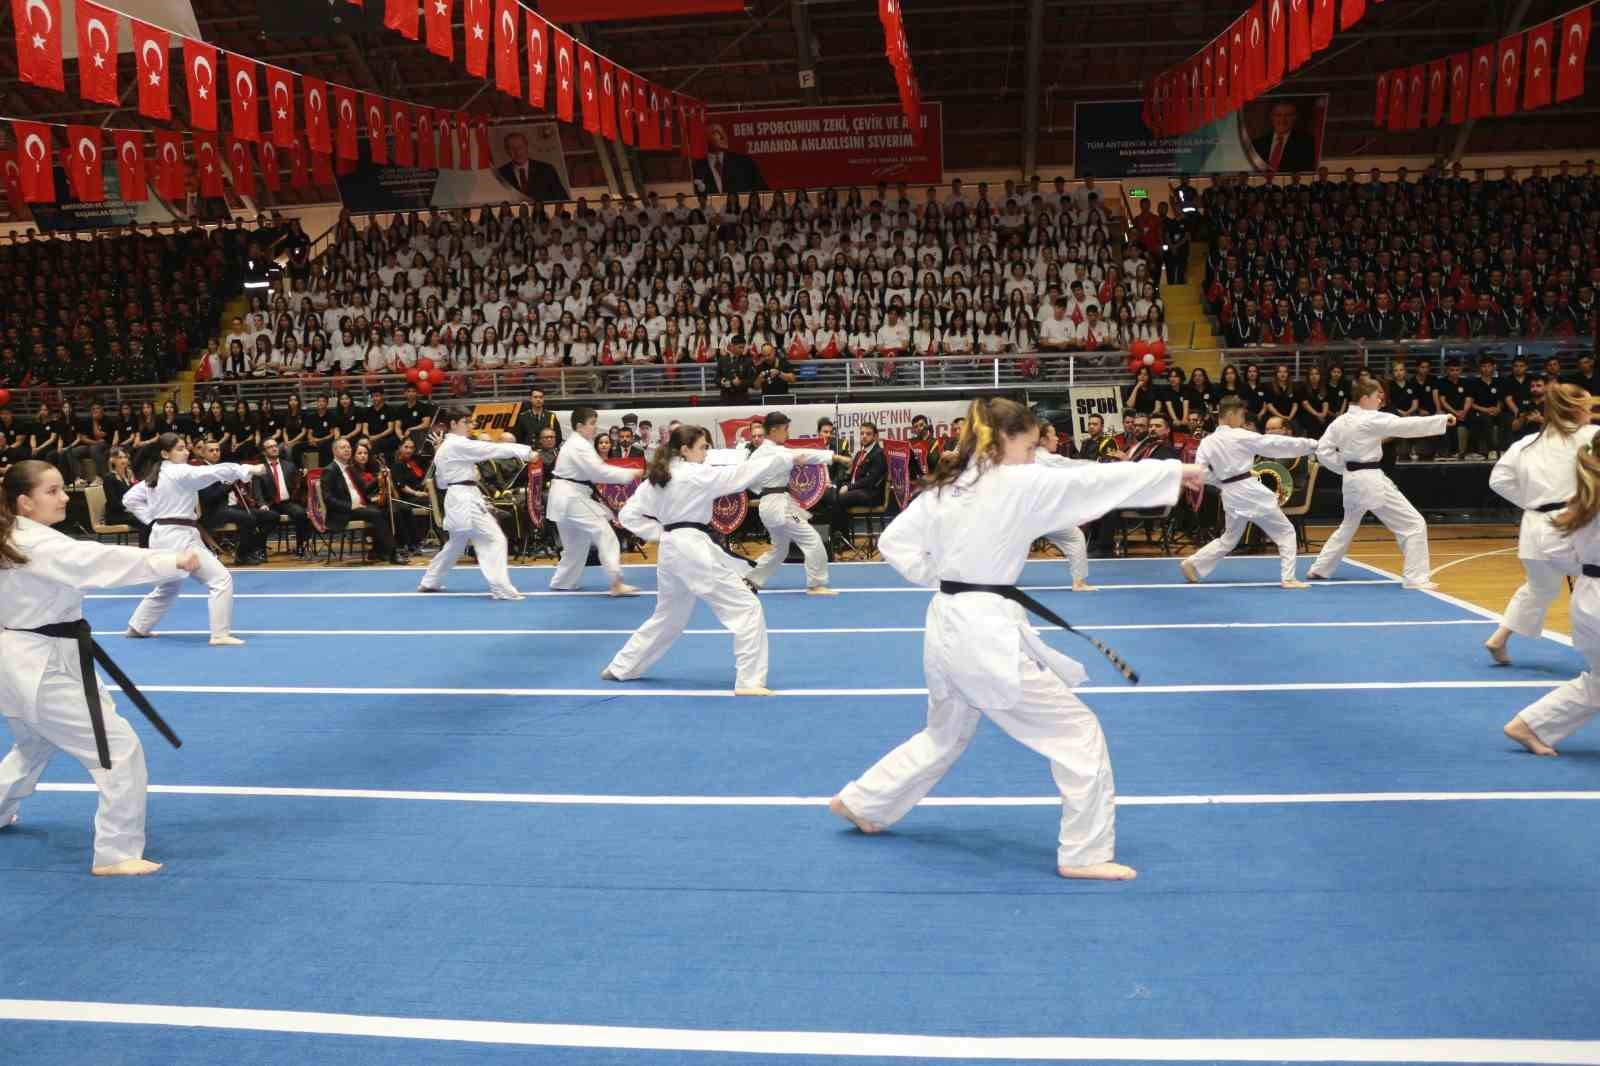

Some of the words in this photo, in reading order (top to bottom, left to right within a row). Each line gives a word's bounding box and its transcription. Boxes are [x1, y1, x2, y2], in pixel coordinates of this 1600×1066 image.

[734, 123, 754, 136] BEN
[757, 119, 820, 135] SPORCUNUN
[885, 115, 901, 129] VE
[747, 139, 799, 154] ZAMANDA
